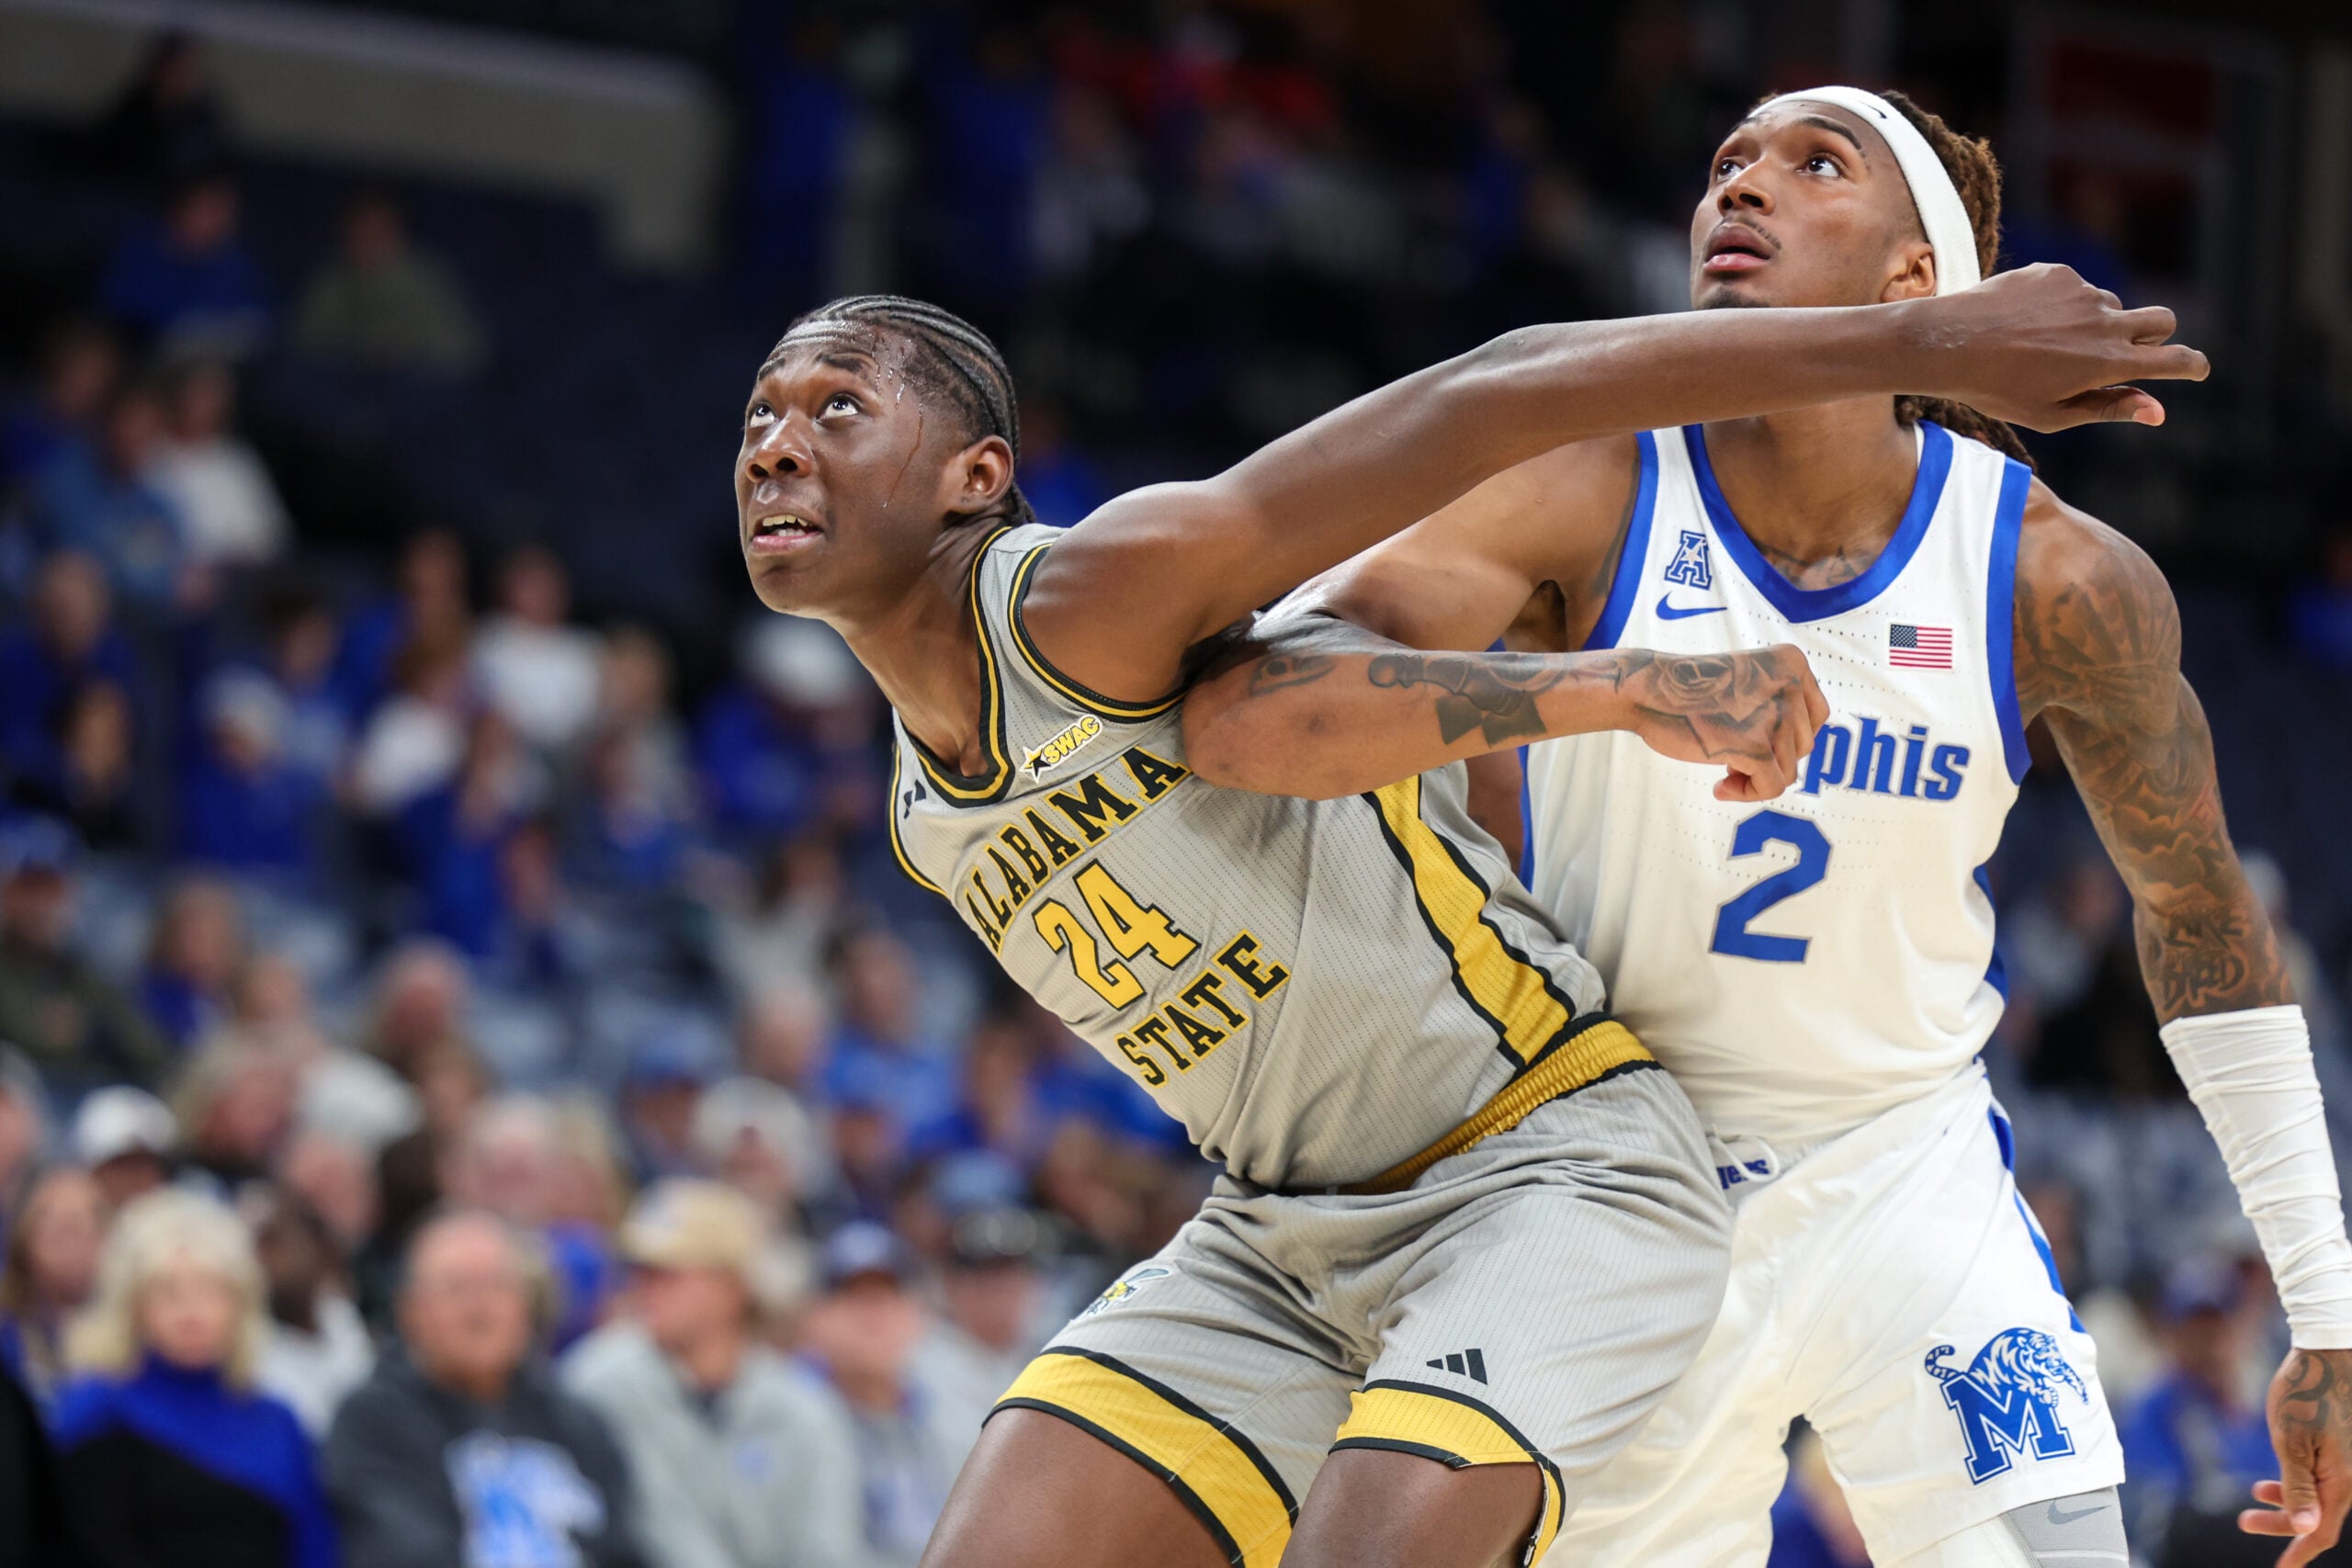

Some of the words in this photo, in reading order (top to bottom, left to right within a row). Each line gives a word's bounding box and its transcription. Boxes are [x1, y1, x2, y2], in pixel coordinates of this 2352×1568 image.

[1043, 716, 1100, 764] SWAC
[1795, 713, 1970, 803] phis
[962, 747, 1192, 955] ALABAMA
[1710, 809, 1832, 963] 2
[1033, 860, 1201, 1010] 24
[1116, 930, 1289, 1087] STATE
[1940, 1372, 2075, 1485] M
